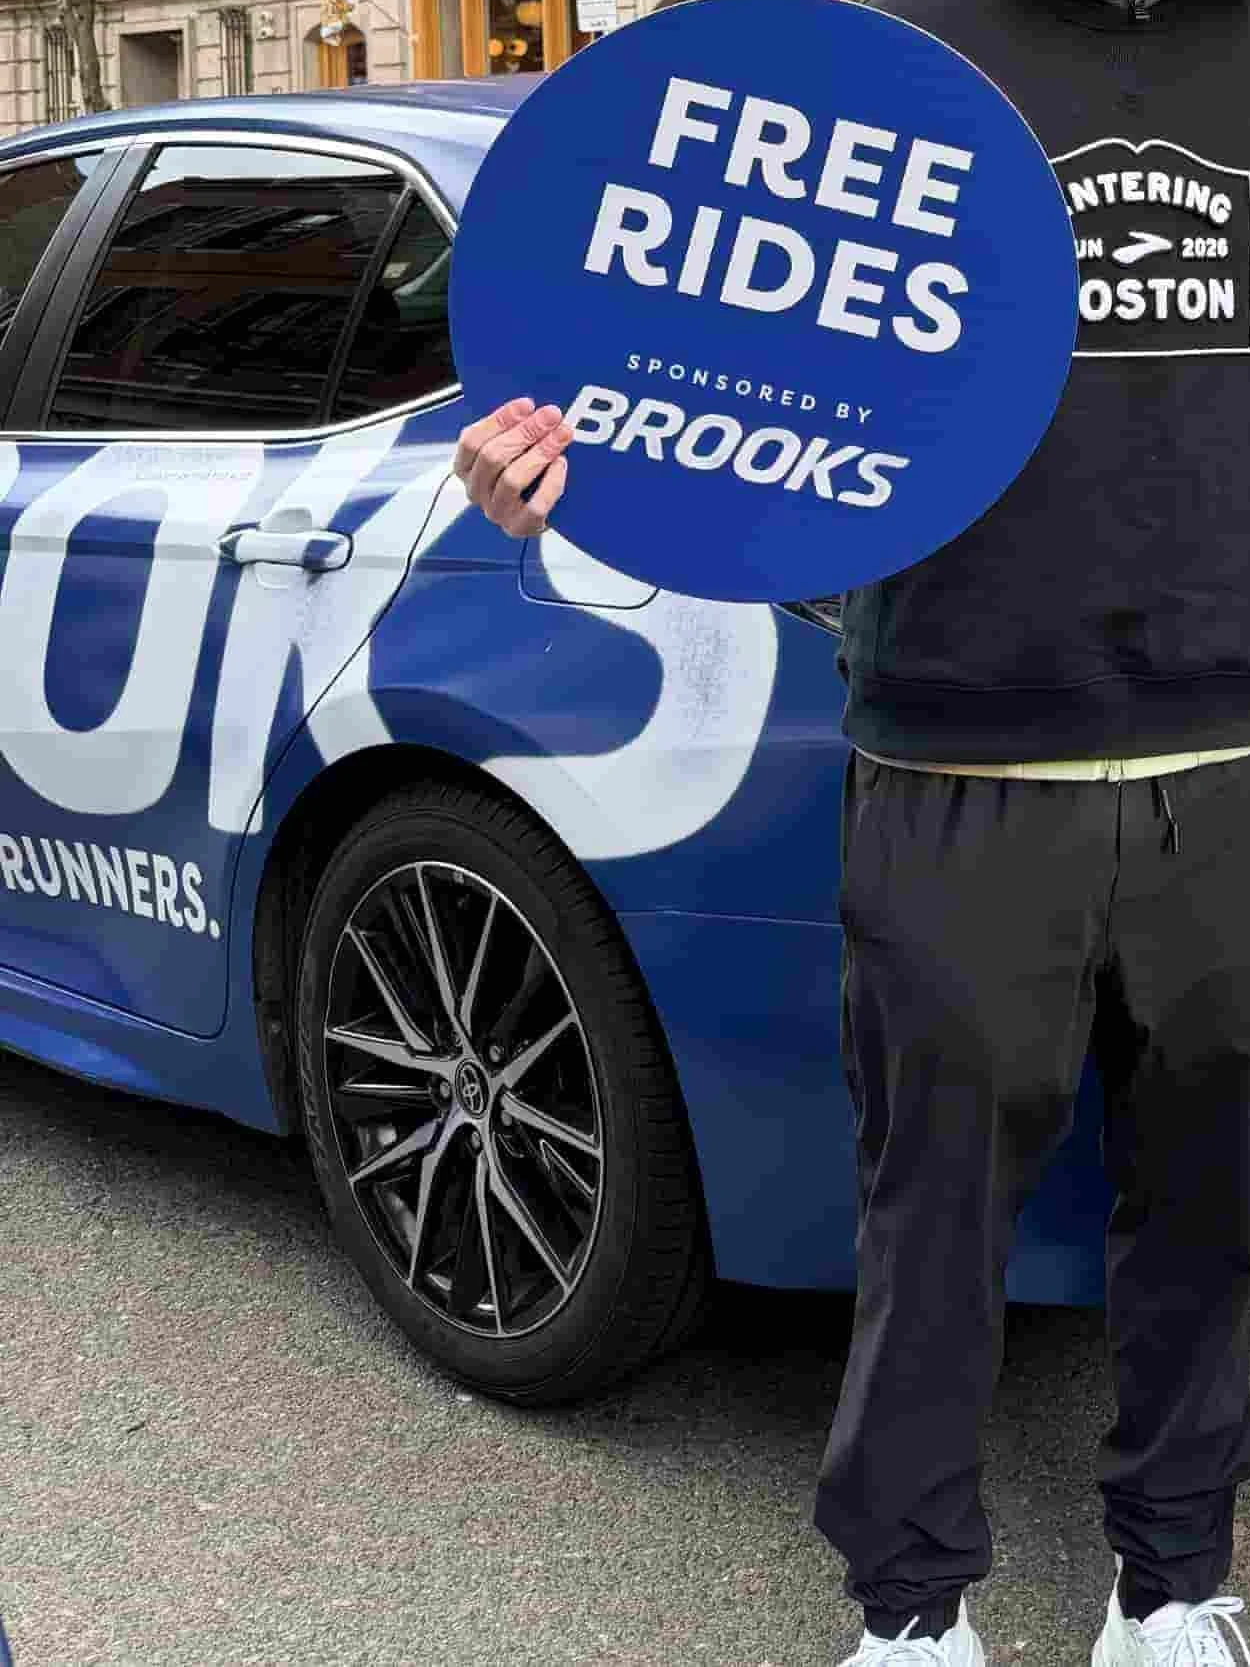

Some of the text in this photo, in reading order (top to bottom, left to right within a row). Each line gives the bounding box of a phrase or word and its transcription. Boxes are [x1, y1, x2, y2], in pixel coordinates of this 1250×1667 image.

[648, 77, 975, 238] FREE
[1066, 171, 1232, 224] NTERING
[583, 182, 970, 354] RIDES
[1077, 237, 1229, 259] UN 2026
[1078, 278, 1235, 322] OSTON
[626, 353, 874, 424] SPONSORED BY
[563, 384, 911, 509] BROOKS
[0, 417, 778, 861] OKS
[0, 833, 220, 940] RUNNERS.
